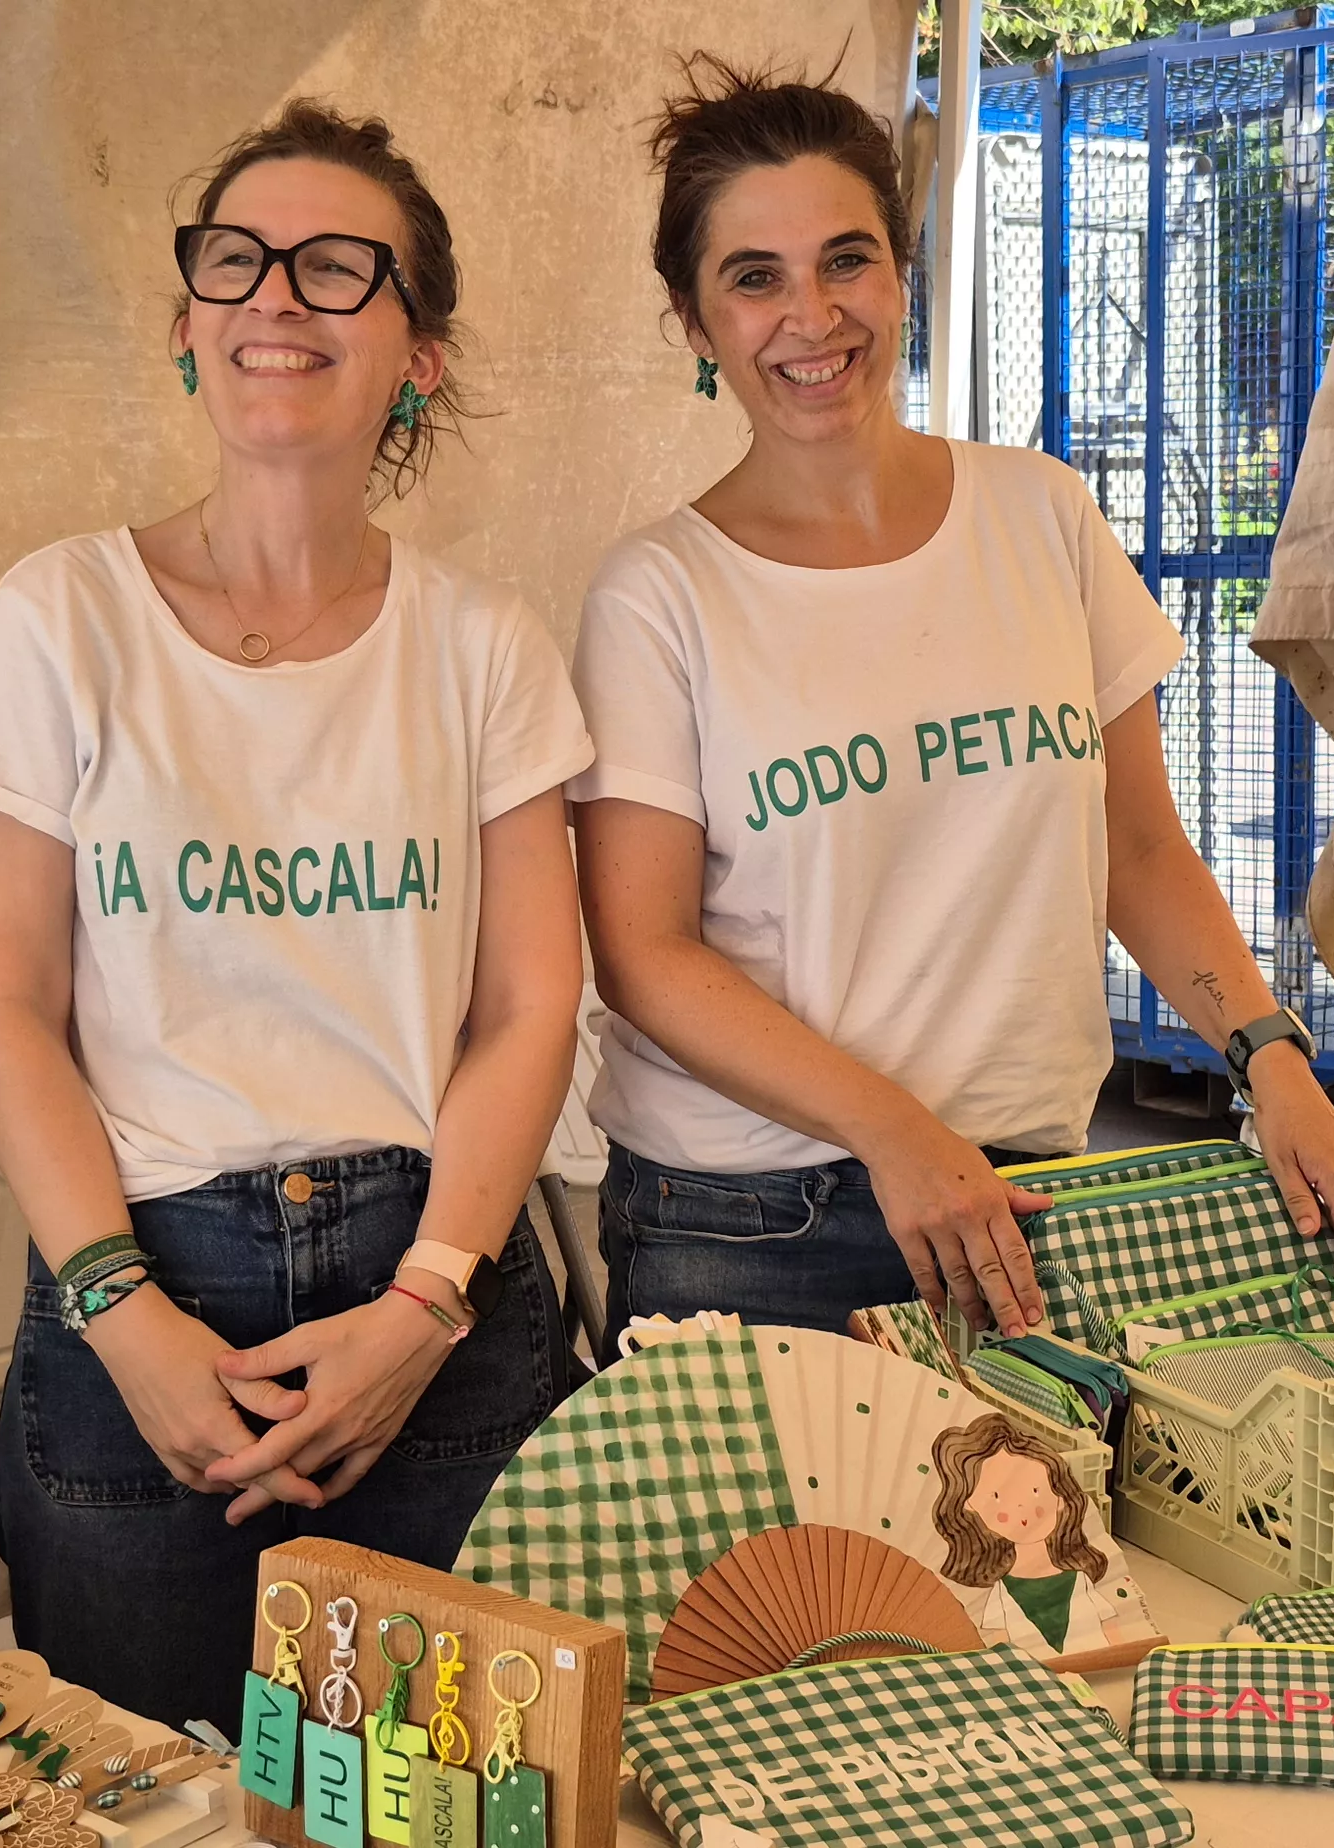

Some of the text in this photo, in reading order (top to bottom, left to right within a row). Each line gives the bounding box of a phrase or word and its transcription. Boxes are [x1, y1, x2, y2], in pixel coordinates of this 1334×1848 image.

[745, 733, 888, 832] JODO
[178, 838, 440, 917] CASCALA!
[254, 1689, 283, 1786] HTV
[710, 1721, 1066, 1818] DE PISTÓN
[319, 1750, 349, 1827] HU
